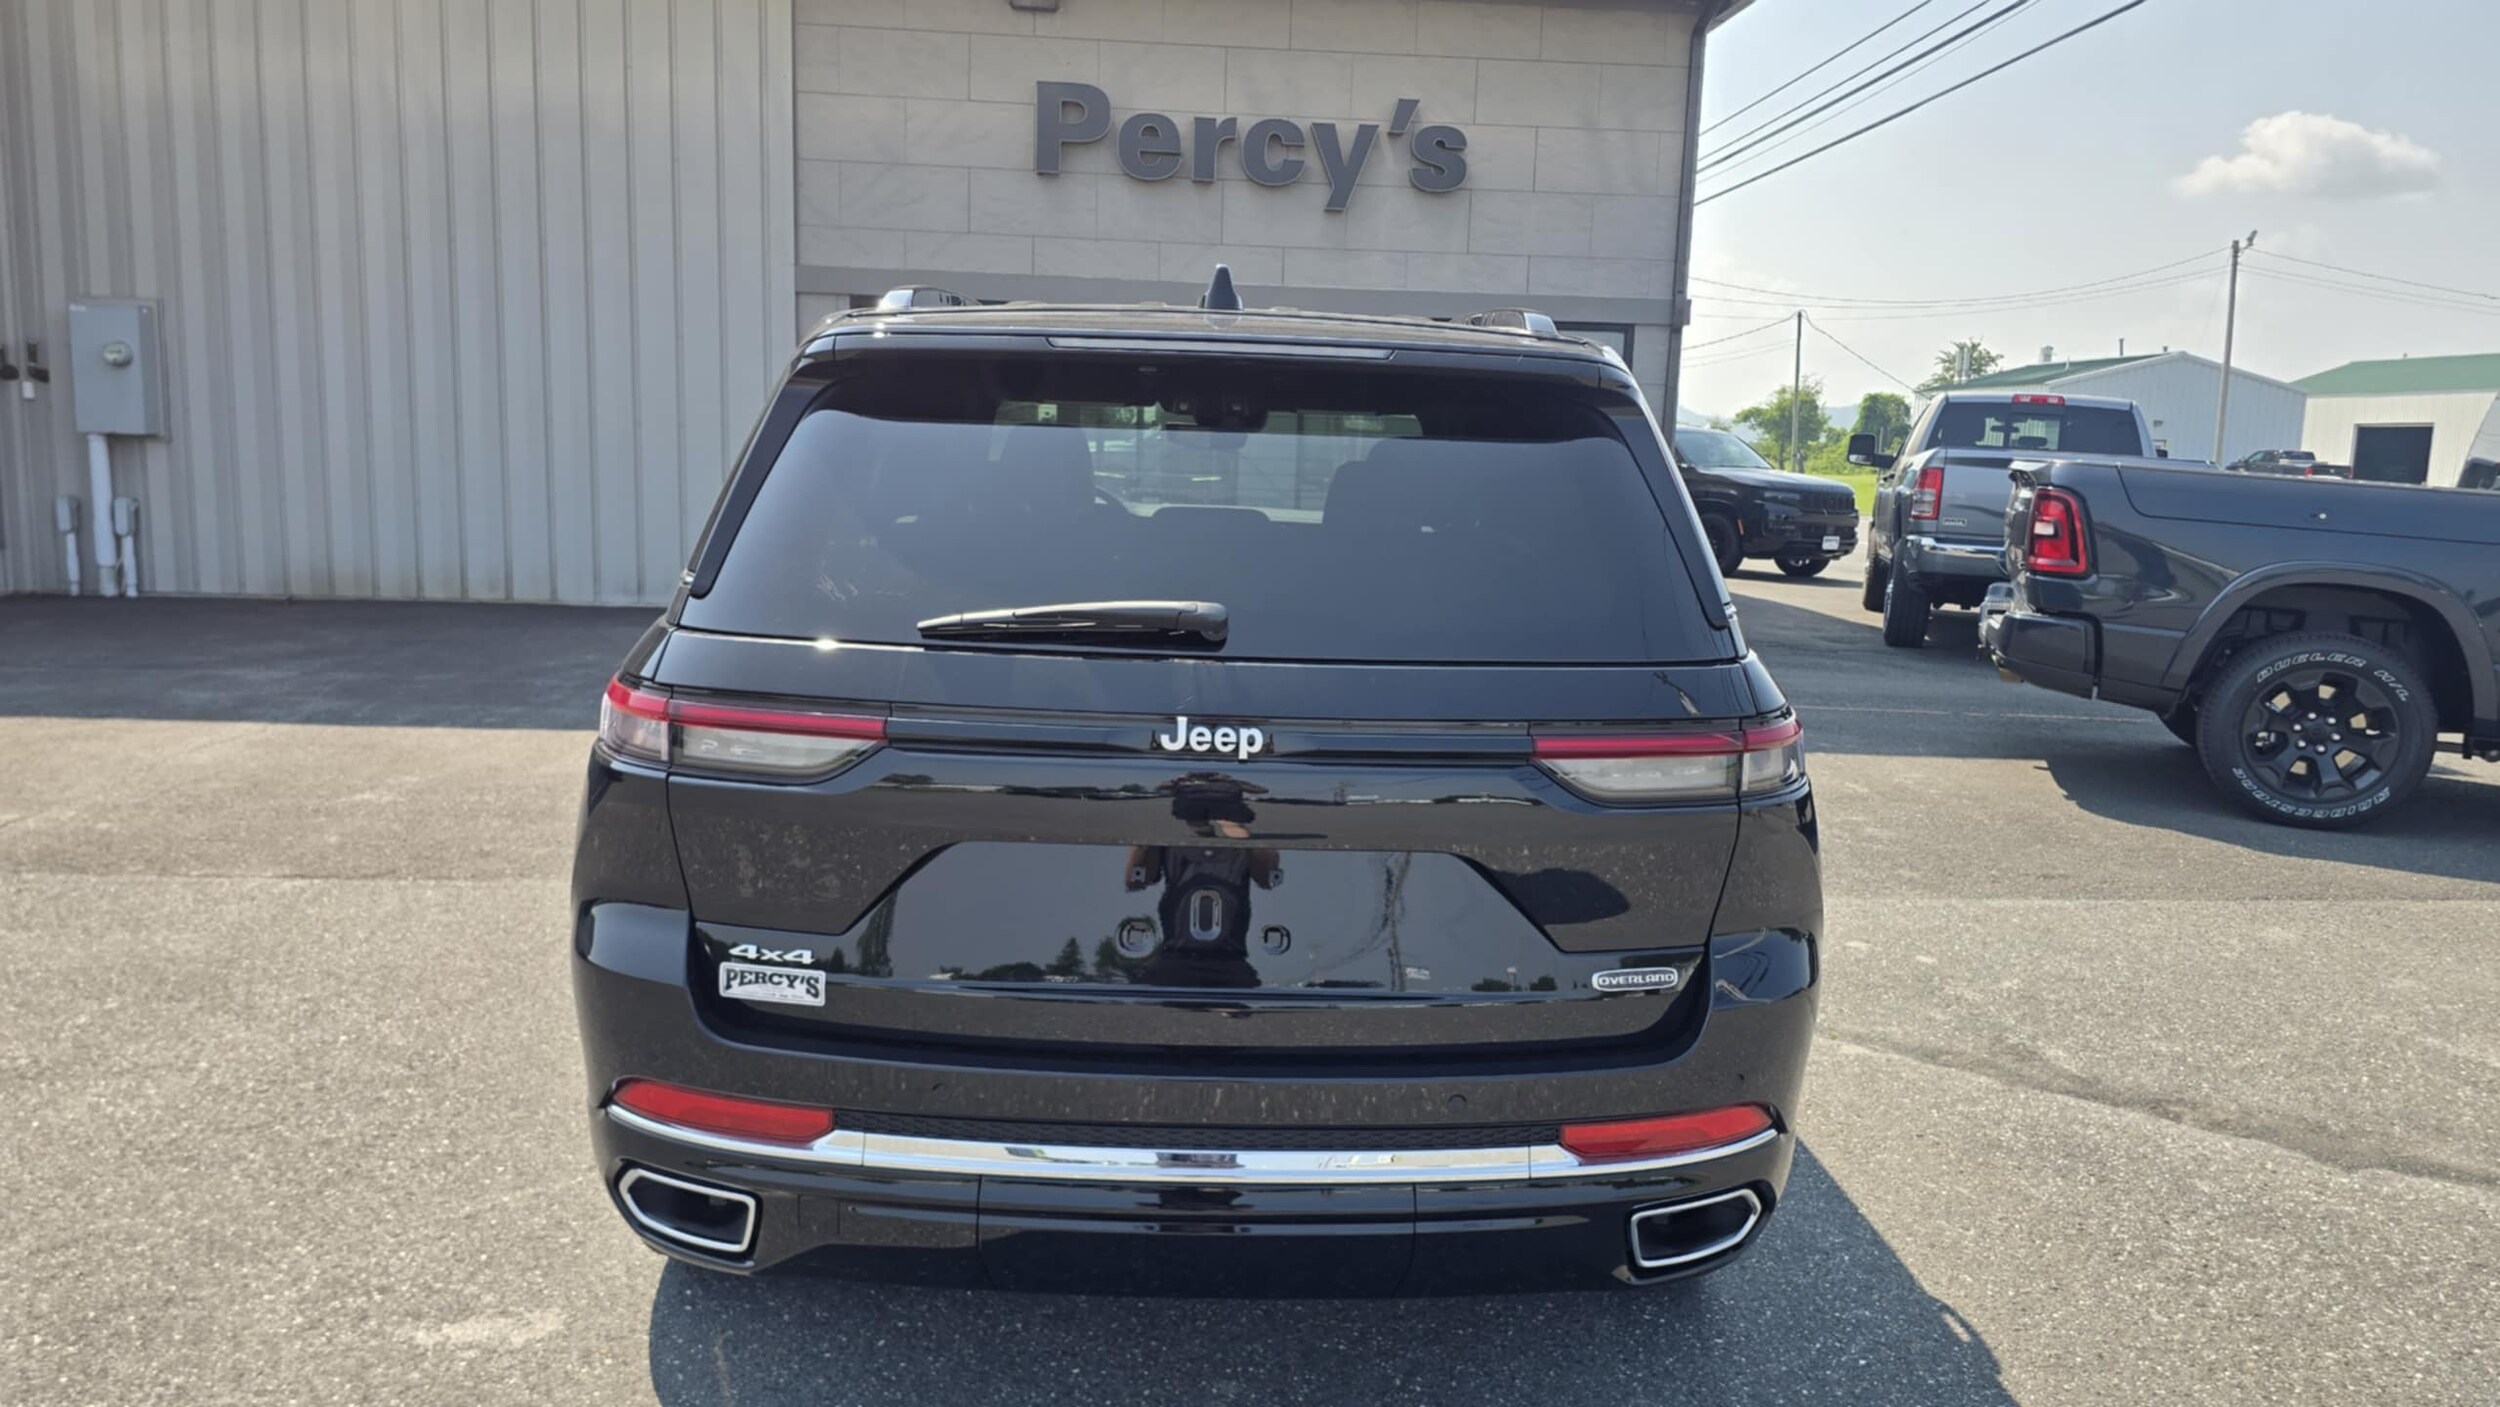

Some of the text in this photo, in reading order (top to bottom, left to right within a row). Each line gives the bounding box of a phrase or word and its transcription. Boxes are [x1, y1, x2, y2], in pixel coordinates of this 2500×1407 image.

[1034, 80, 1468, 212] Percy's
[1160, 716, 1264, 760] Jeep
[728, 944, 815, 965] 4x4
[725, 968, 820, 999] PERCY'S
[1599, 972, 1675, 986] OVERLAND
